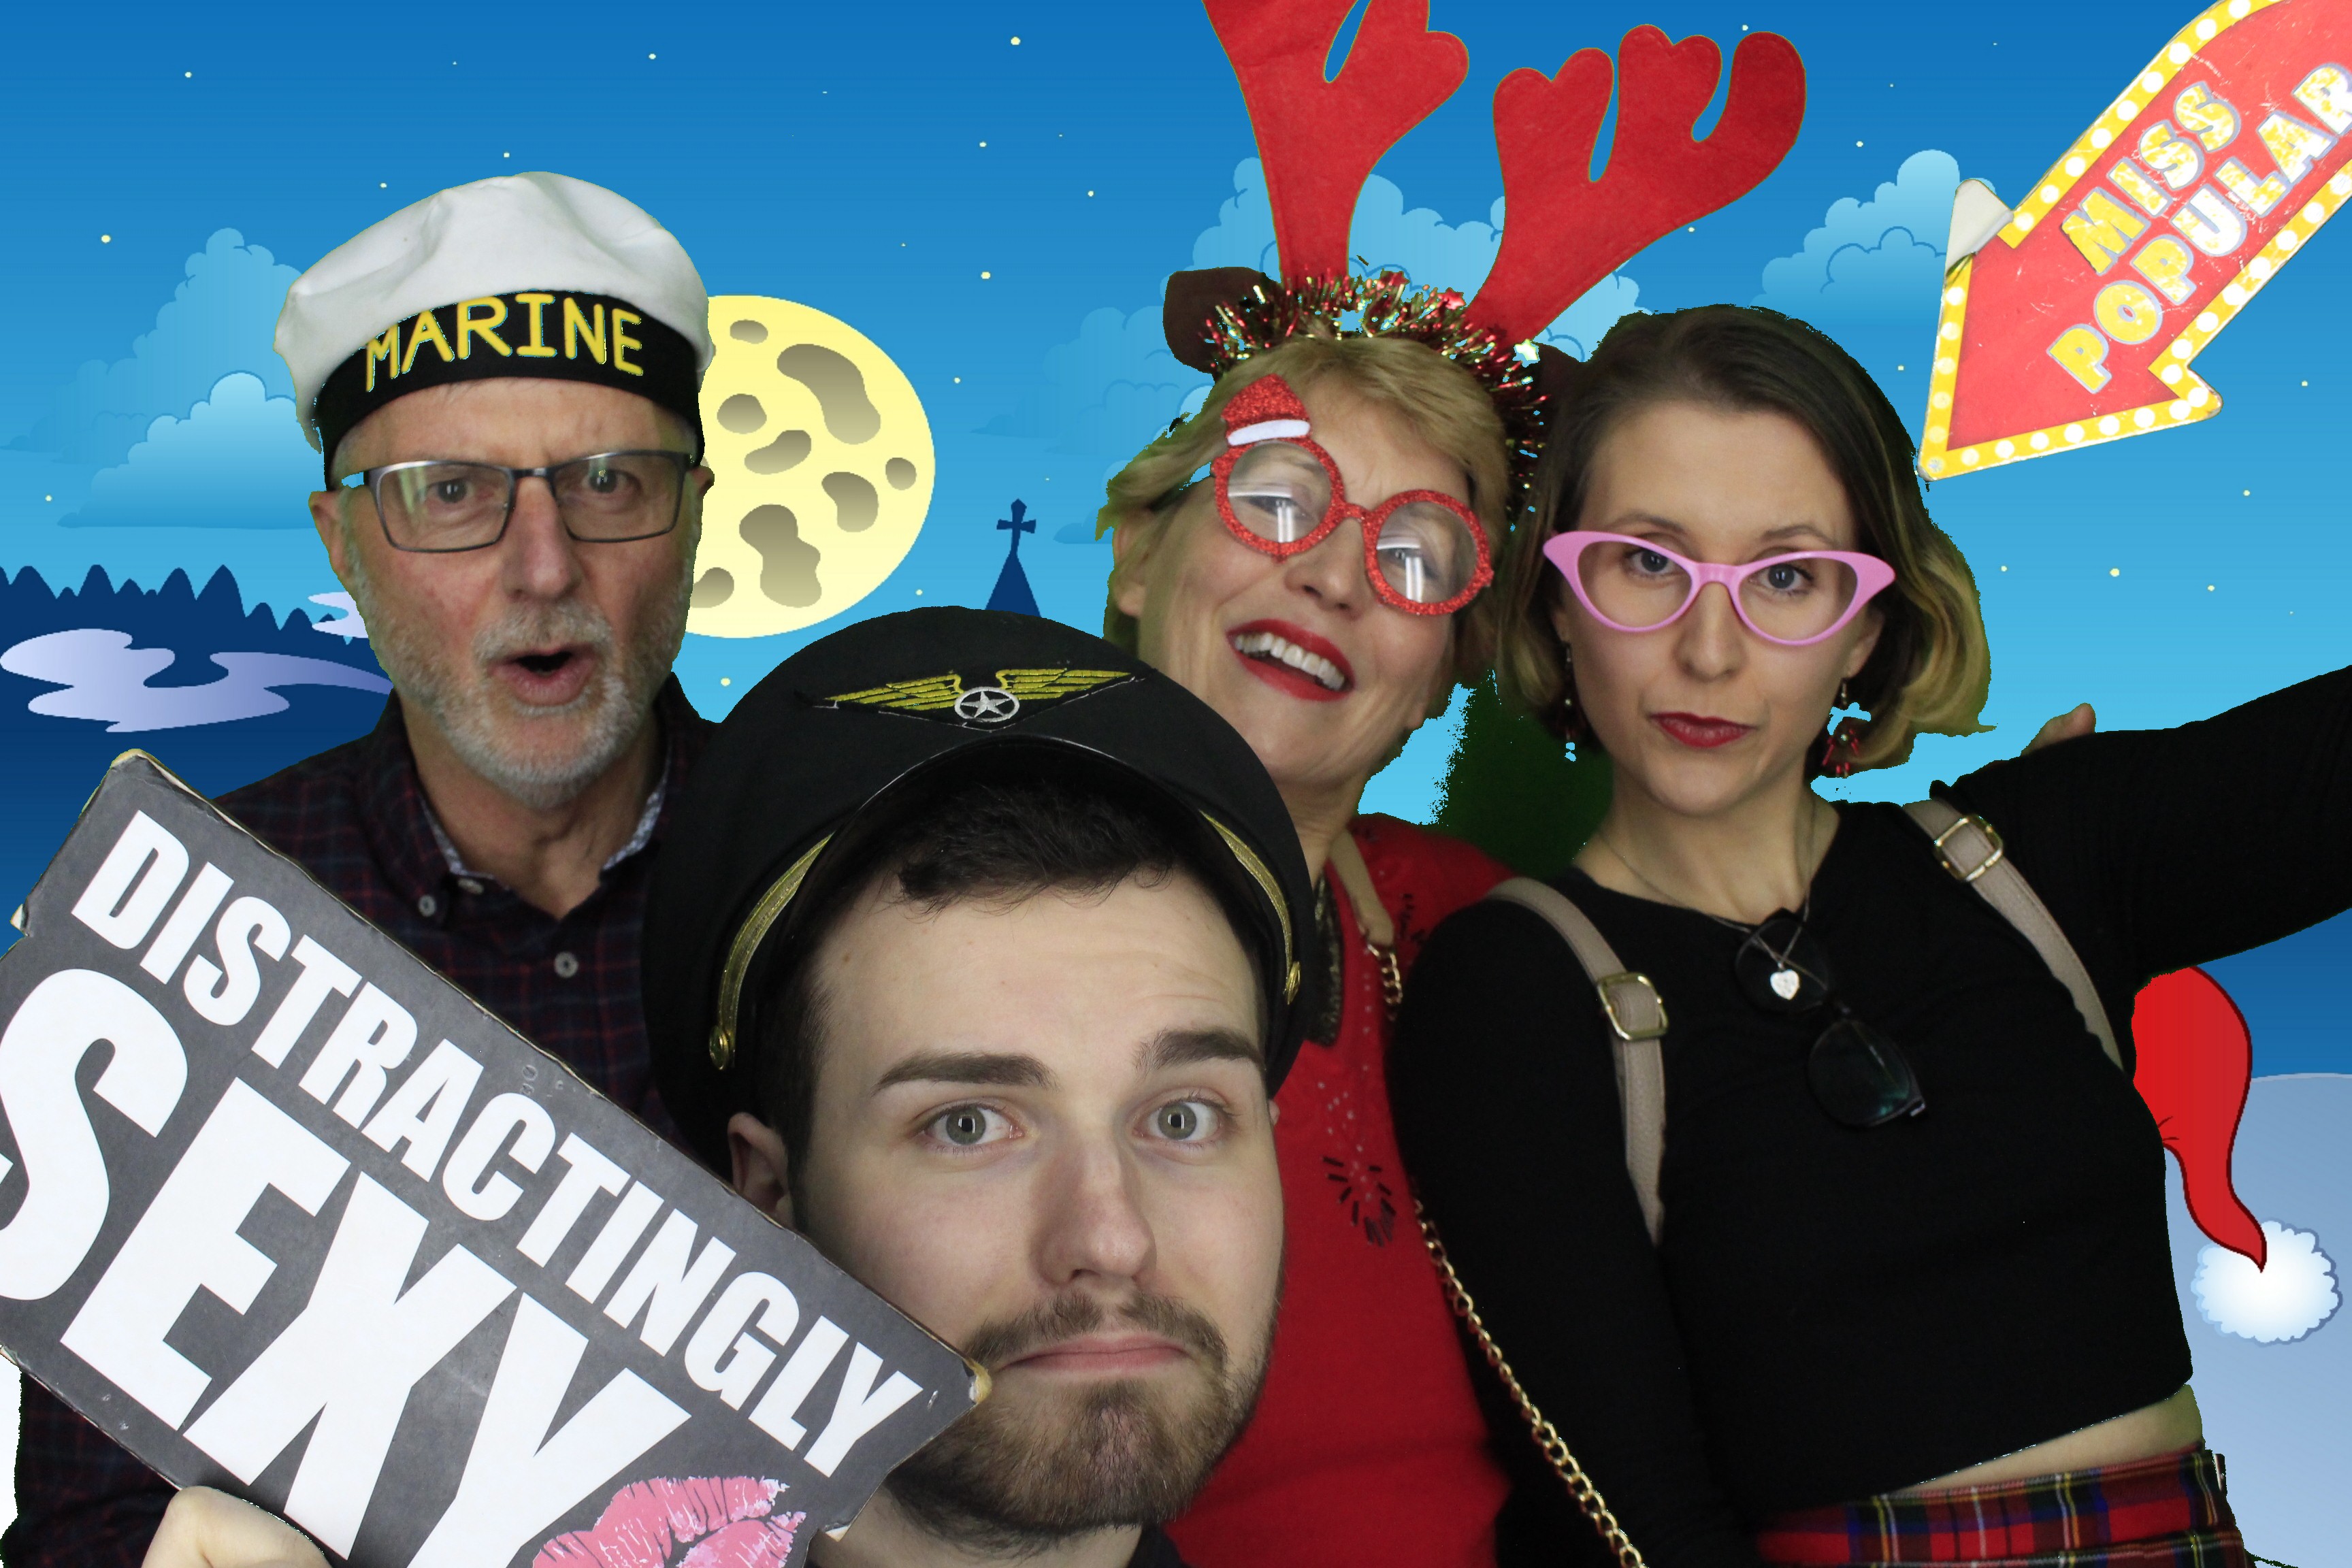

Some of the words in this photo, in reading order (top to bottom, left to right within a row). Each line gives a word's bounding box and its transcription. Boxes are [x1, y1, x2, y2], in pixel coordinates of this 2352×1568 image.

[366, 293, 643, 392] MARINE
[2046, 62, 2352, 394] POPULAR
[2061, 80, 2241, 276] MISS
[0, 968, 691, 1568] SEXY
[71, 810, 924, 1477] DISTRACTINGLY
